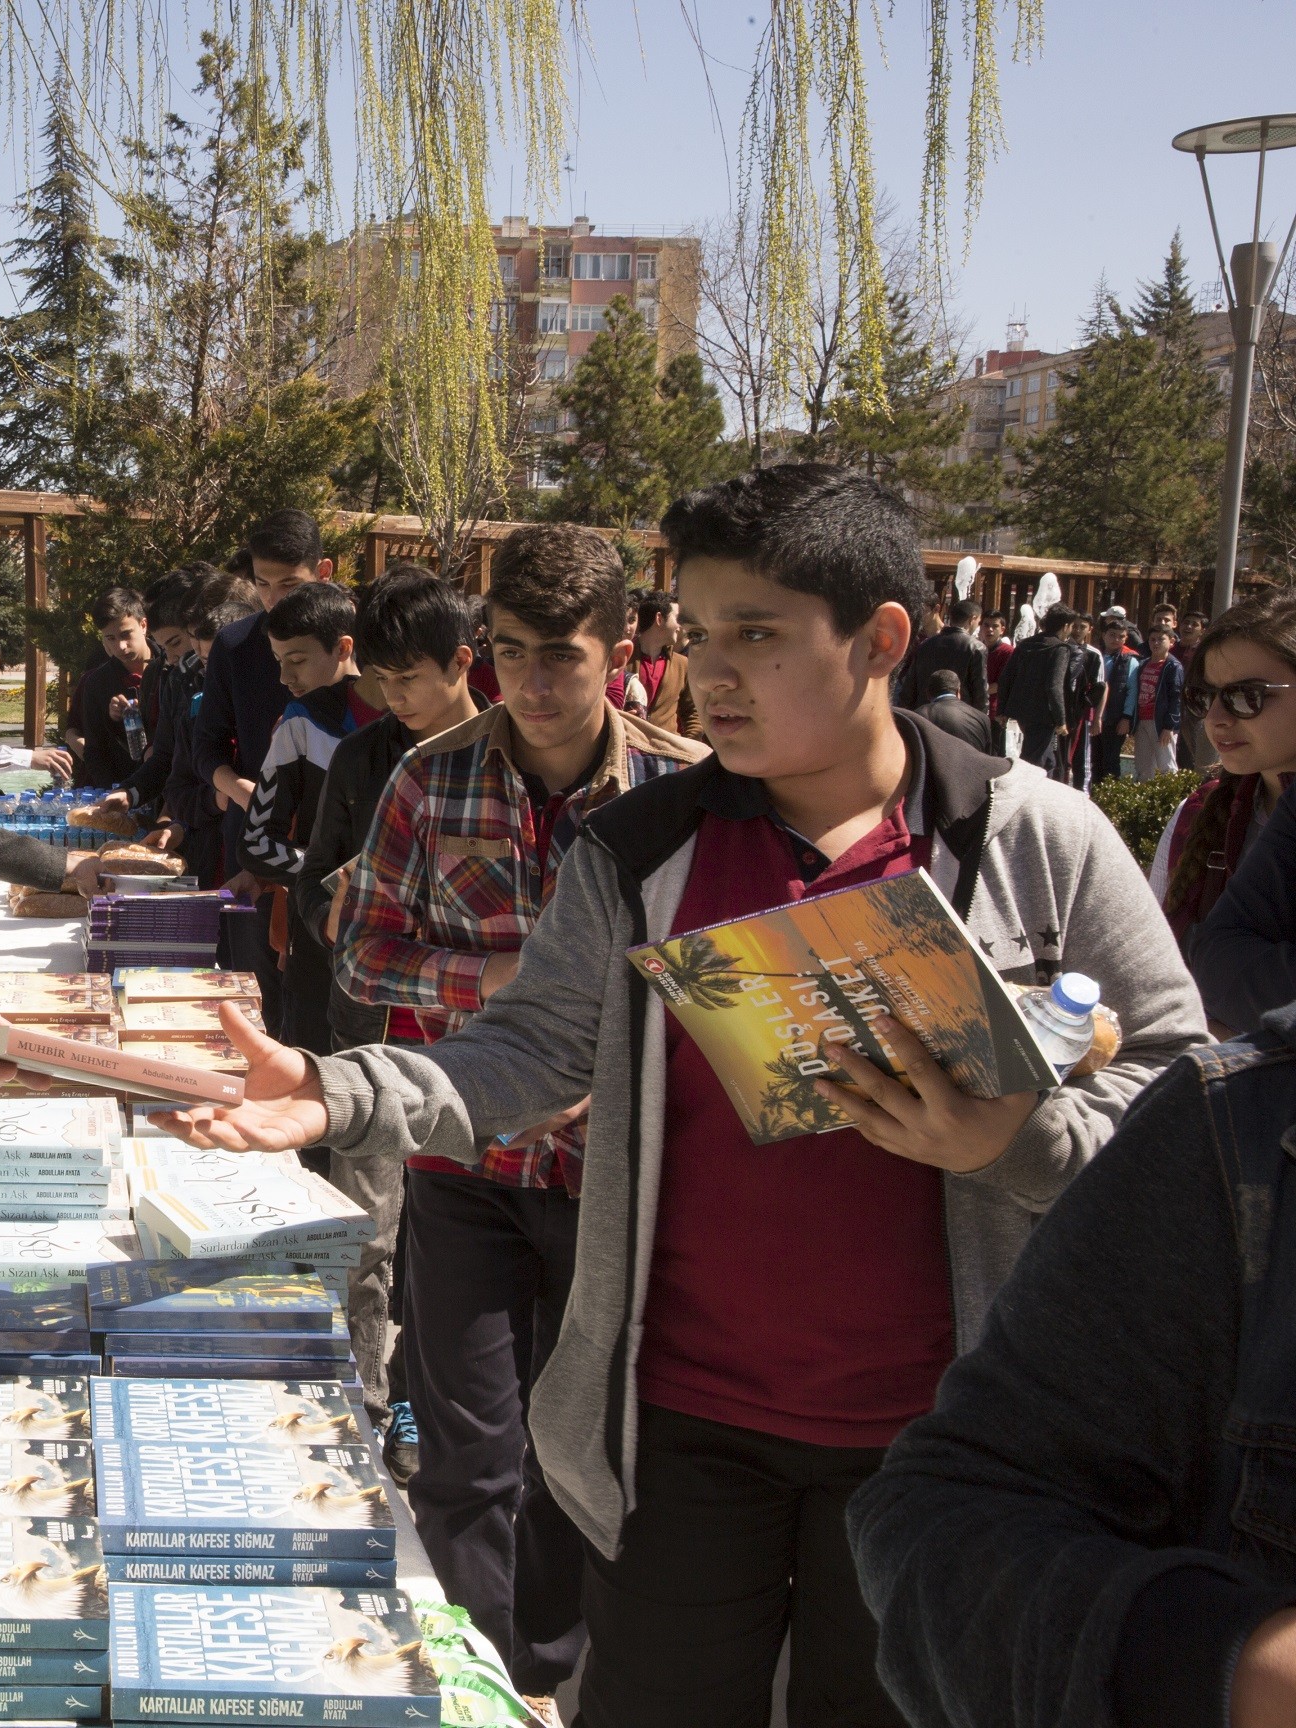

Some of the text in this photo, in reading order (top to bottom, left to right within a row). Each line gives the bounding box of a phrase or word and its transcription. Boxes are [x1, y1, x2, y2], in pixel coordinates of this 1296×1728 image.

[655, 974, 684, 1006] TURKISH
[663, 972, 692, 1004] AIRLINES
[739, 974, 829, 1076] DÜŞLER
[17, 1039, 237, 1095] MUHBİR MEHMET Abdullah AYATA 2015
[3, 1149, 21, 1162] Aşk
[56, 1152, 72, 1160] AYATA
[12, 1167, 30, 1179] Aşk
[65, 1169, 80, 1177] AYATA
[11, 1189, 28, 1200] Aşk
[36, 1191, 62, 1199] ABDULLAH
[0, 1209, 28, 1220] Sızan
[31, 1210, 48, 1221] Aşk
[83, 1212, 99, 1220] AYATA
[200, 1231, 348, 1253] Surlardan Sızan Aşk ABDULLAH AYATA
[8, 1268, 37, 1278] Sızan
[41, 1268, 59, 1280] Aşk
[94, 1382, 112, 1404] AYATA
[127, 1384, 170, 1441] KARTALLAR
[164, 1384, 227, 1443] KAFESE
[102, 1445, 126, 1517] ABDULLAH AYATA
[139, 1446, 187, 1517] KARTALLAR
[178, 1447, 248, 1518] KAFESE
[126, 1531, 275, 1549] KARTALLAR KAFESE SIĞMAZ
[292, 1532, 328, 1542] ABDULLAH
[292, 1541, 314, 1551] AYATA
[126, 1562, 275, 1580] KARTALLAR KAFESE SIĞMAZ
[291, 1572, 313, 1582] AYATA
[292, 1563, 328, 1573] ABDULLAH
[113, 1591, 140, 1679] ABDULLAH AYATA
[154, 1593, 206, 1680] KARTALLAR
[198, 1594, 275, 1682] KAFESE
[139, 1696, 304, 1717] KARTALLAR KAFESE SIĞMAZ
[323, 1699, 363, 1710] ABDULLAH
[323, 1710, 347, 1720] AYATA
